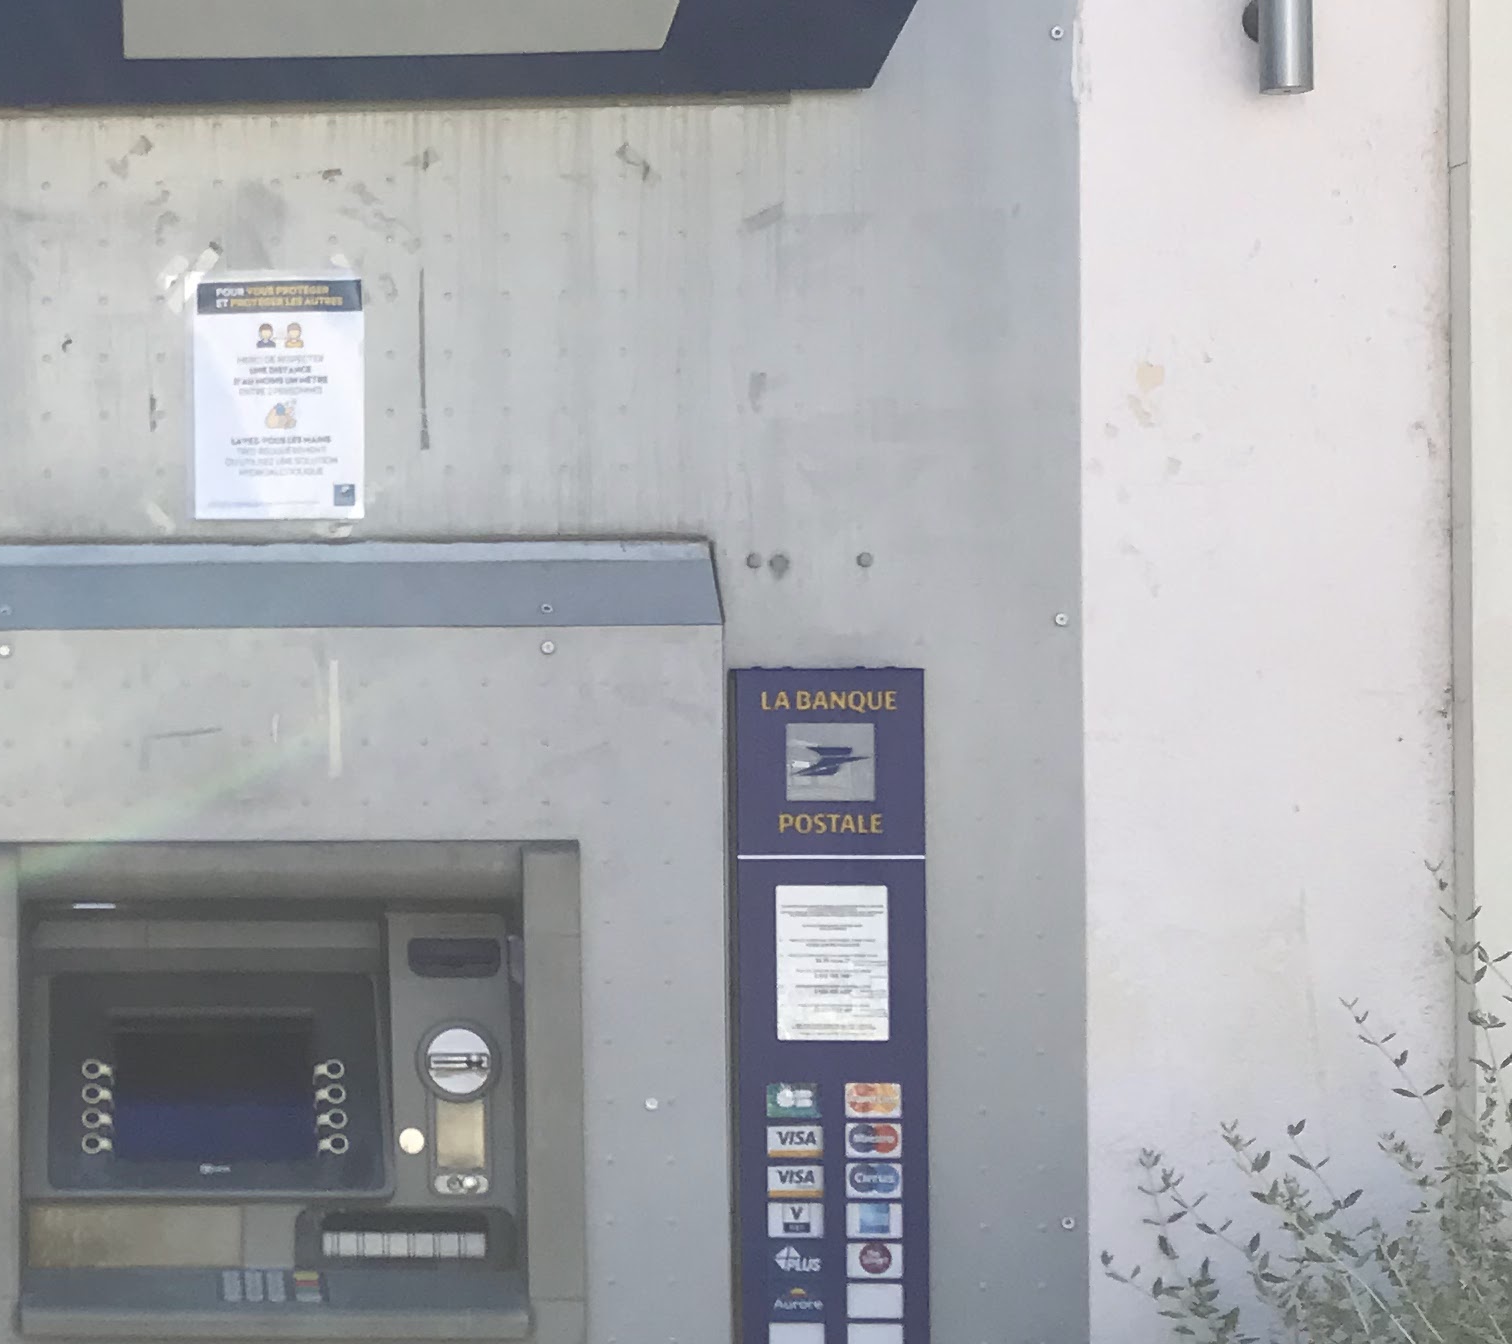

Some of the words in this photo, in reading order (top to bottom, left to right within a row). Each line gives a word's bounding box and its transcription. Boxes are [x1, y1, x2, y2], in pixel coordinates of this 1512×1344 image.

[760, 691, 791, 711] LA
[795, 690, 898, 713] BANQUE
[778, 813, 884, 835] POSTALE
[777, 1131, 817, 1146] VISA
[778, 1169, 816, 1185] VISA
